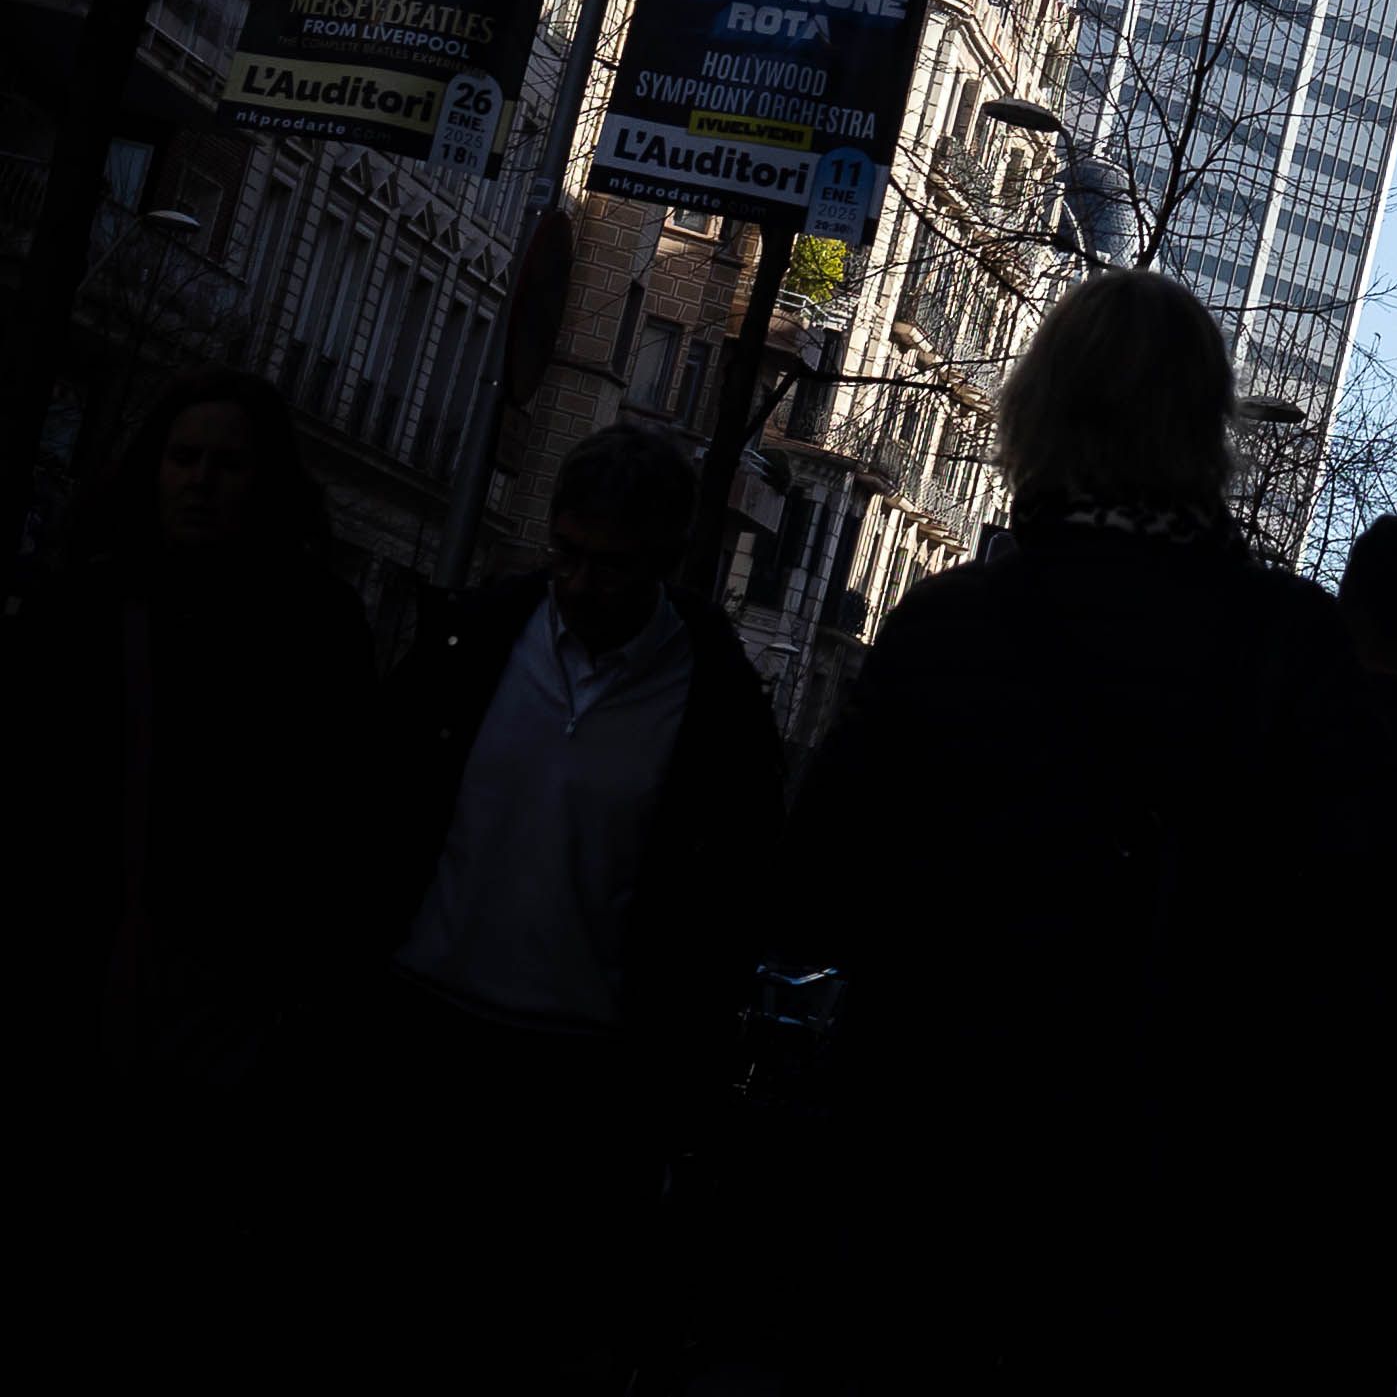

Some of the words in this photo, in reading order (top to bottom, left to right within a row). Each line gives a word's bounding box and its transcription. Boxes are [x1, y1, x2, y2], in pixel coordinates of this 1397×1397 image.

[303, 19, 357, 38] FROM
[362, 23, 471, 60] LIVERPOOL
[726, 1, 832, 44] ROTA
[701, 50, 829, 97] HOLLYWOOD
[242, 65, 437, 122] L'Auditori
[452, 83, 491, 114] 26
[635, 70, 757, 116] SYMPHONY
[757, 90, 878, 141] ORCHESTRA
[444, 127, 483, 149] 2025
[448, 112, 485, 132] ENE.
[441, 144, 478, 167] 18h
[613, 128, 810, 194] L'Auditori
[831, 159, 862, 187] 11
[817, 204, 858, 222] 2025
